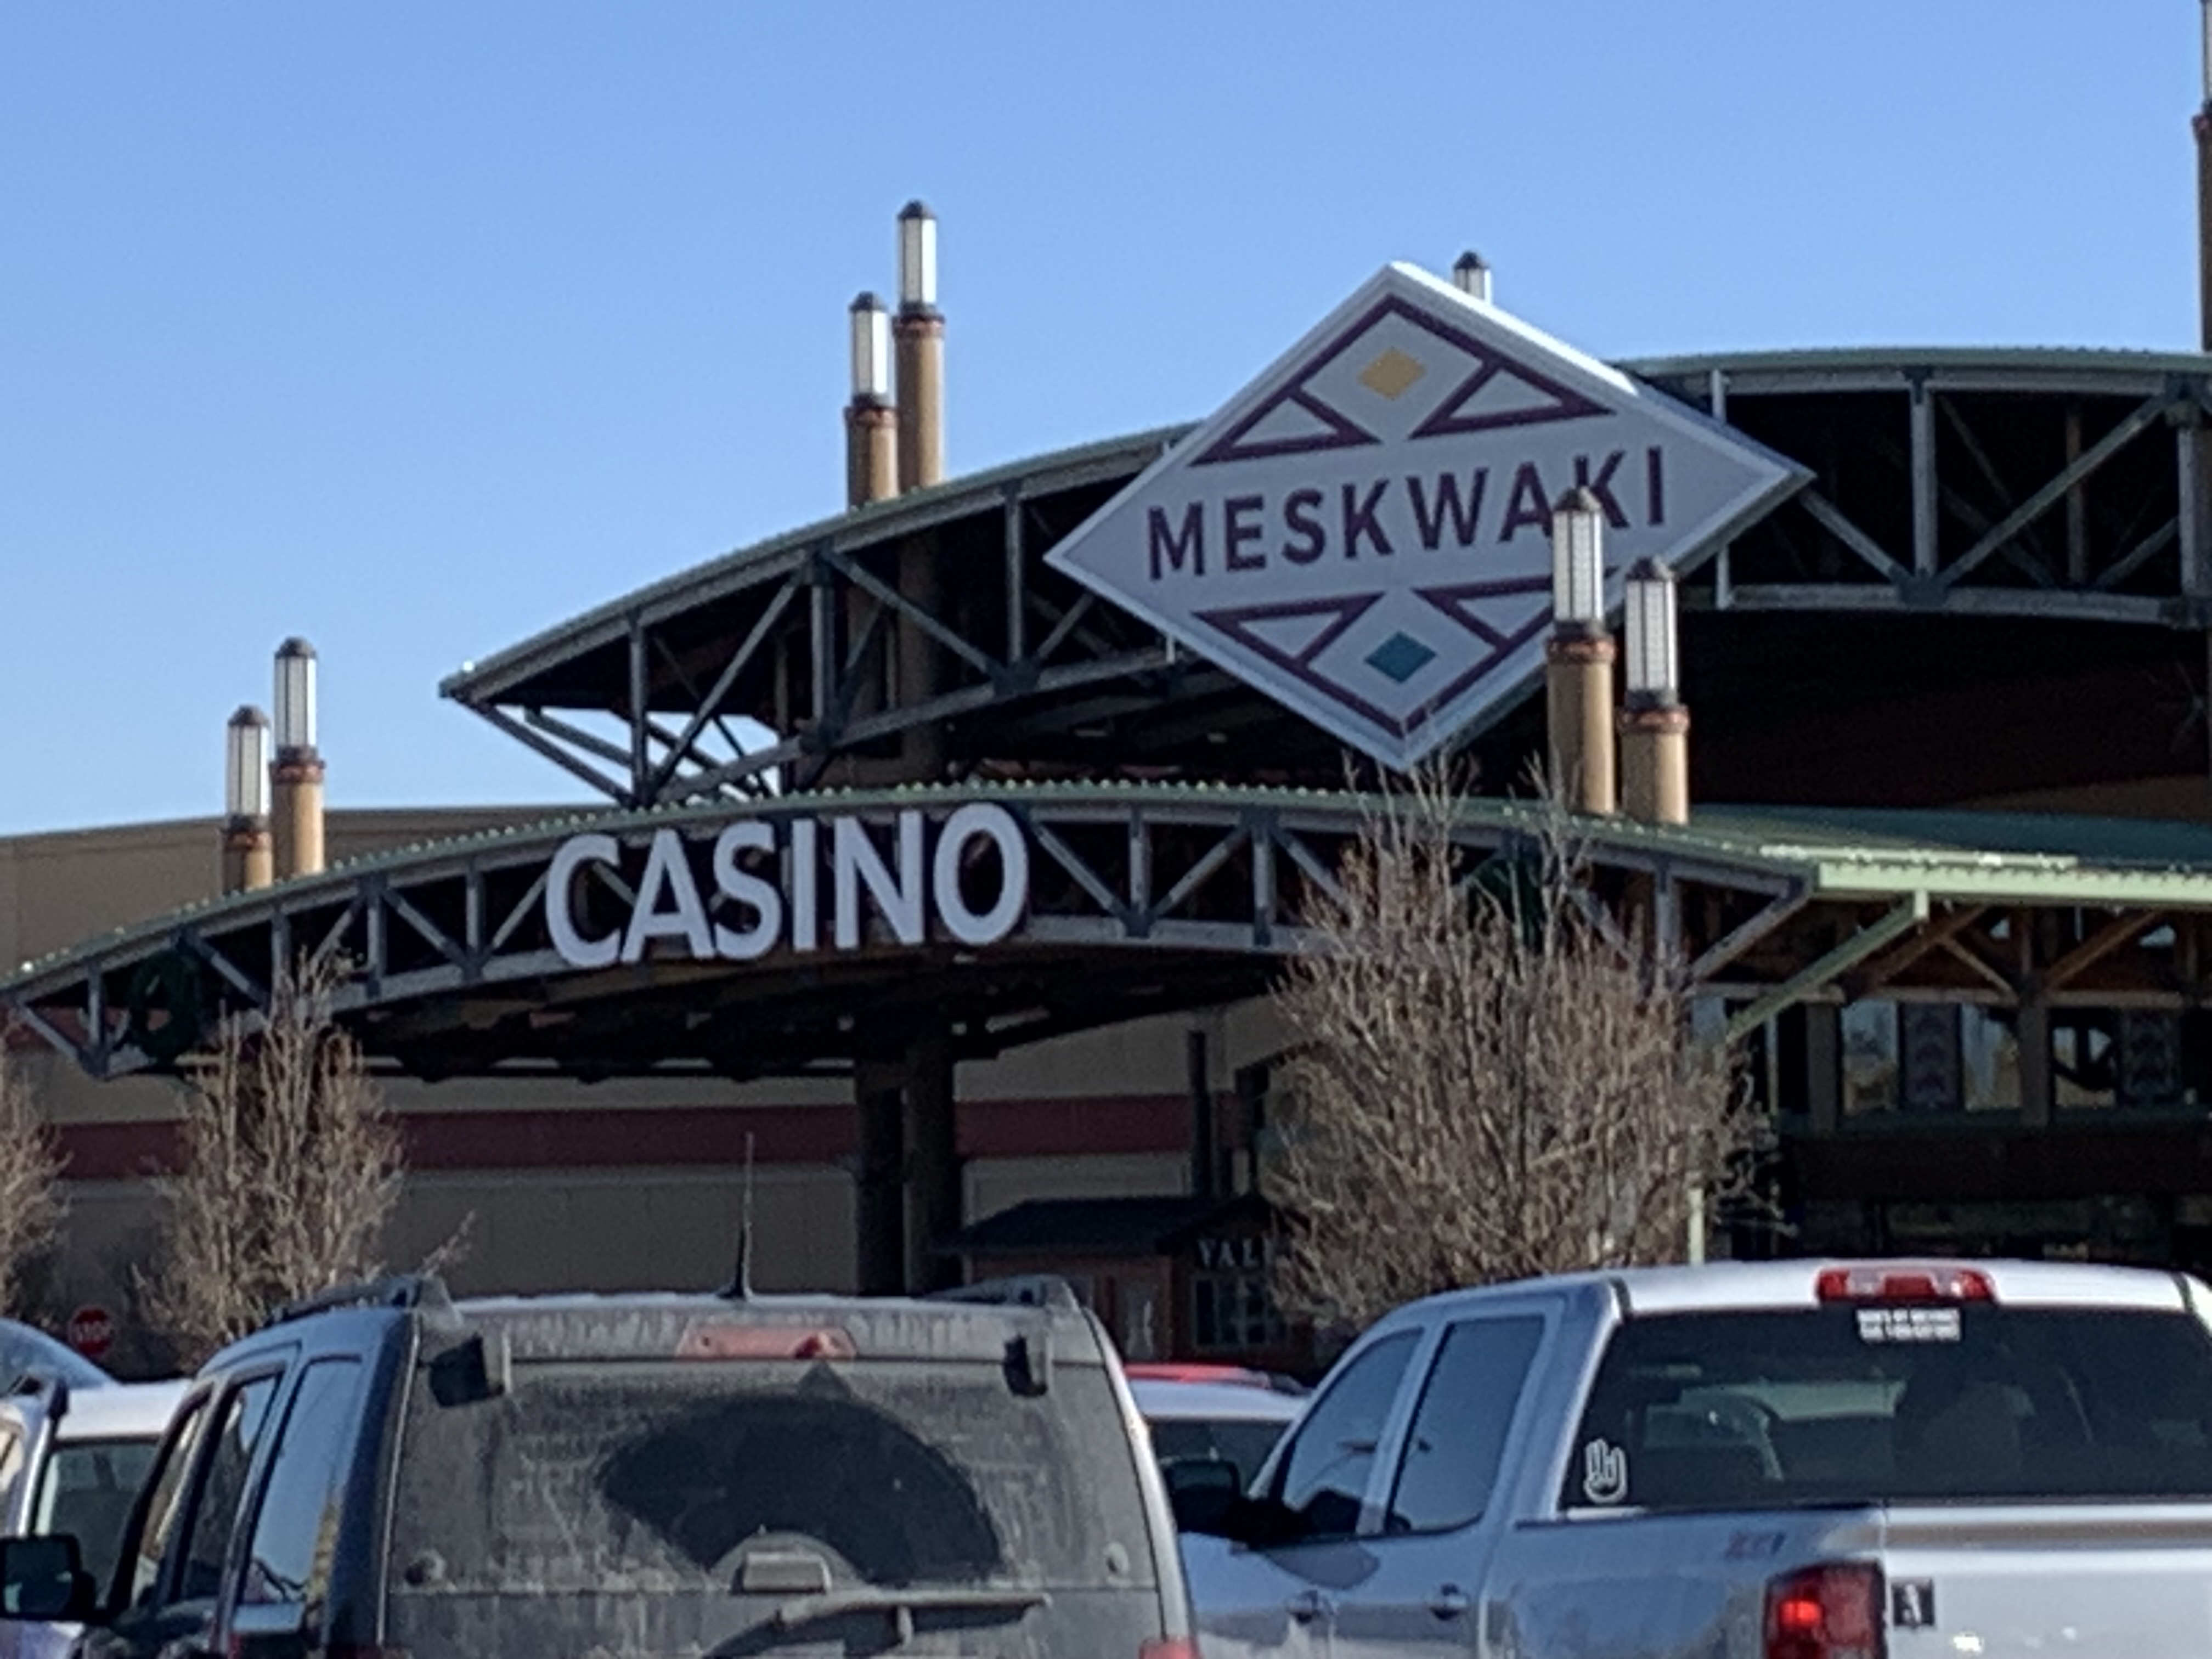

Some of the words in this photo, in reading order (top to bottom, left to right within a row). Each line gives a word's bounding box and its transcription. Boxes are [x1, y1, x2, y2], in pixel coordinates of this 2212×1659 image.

[1148, 445, 1664, 580] MESKWAKI
[545, 802, 1028, 967] CASINO
[75, 1321, 110, 1343] STOP
